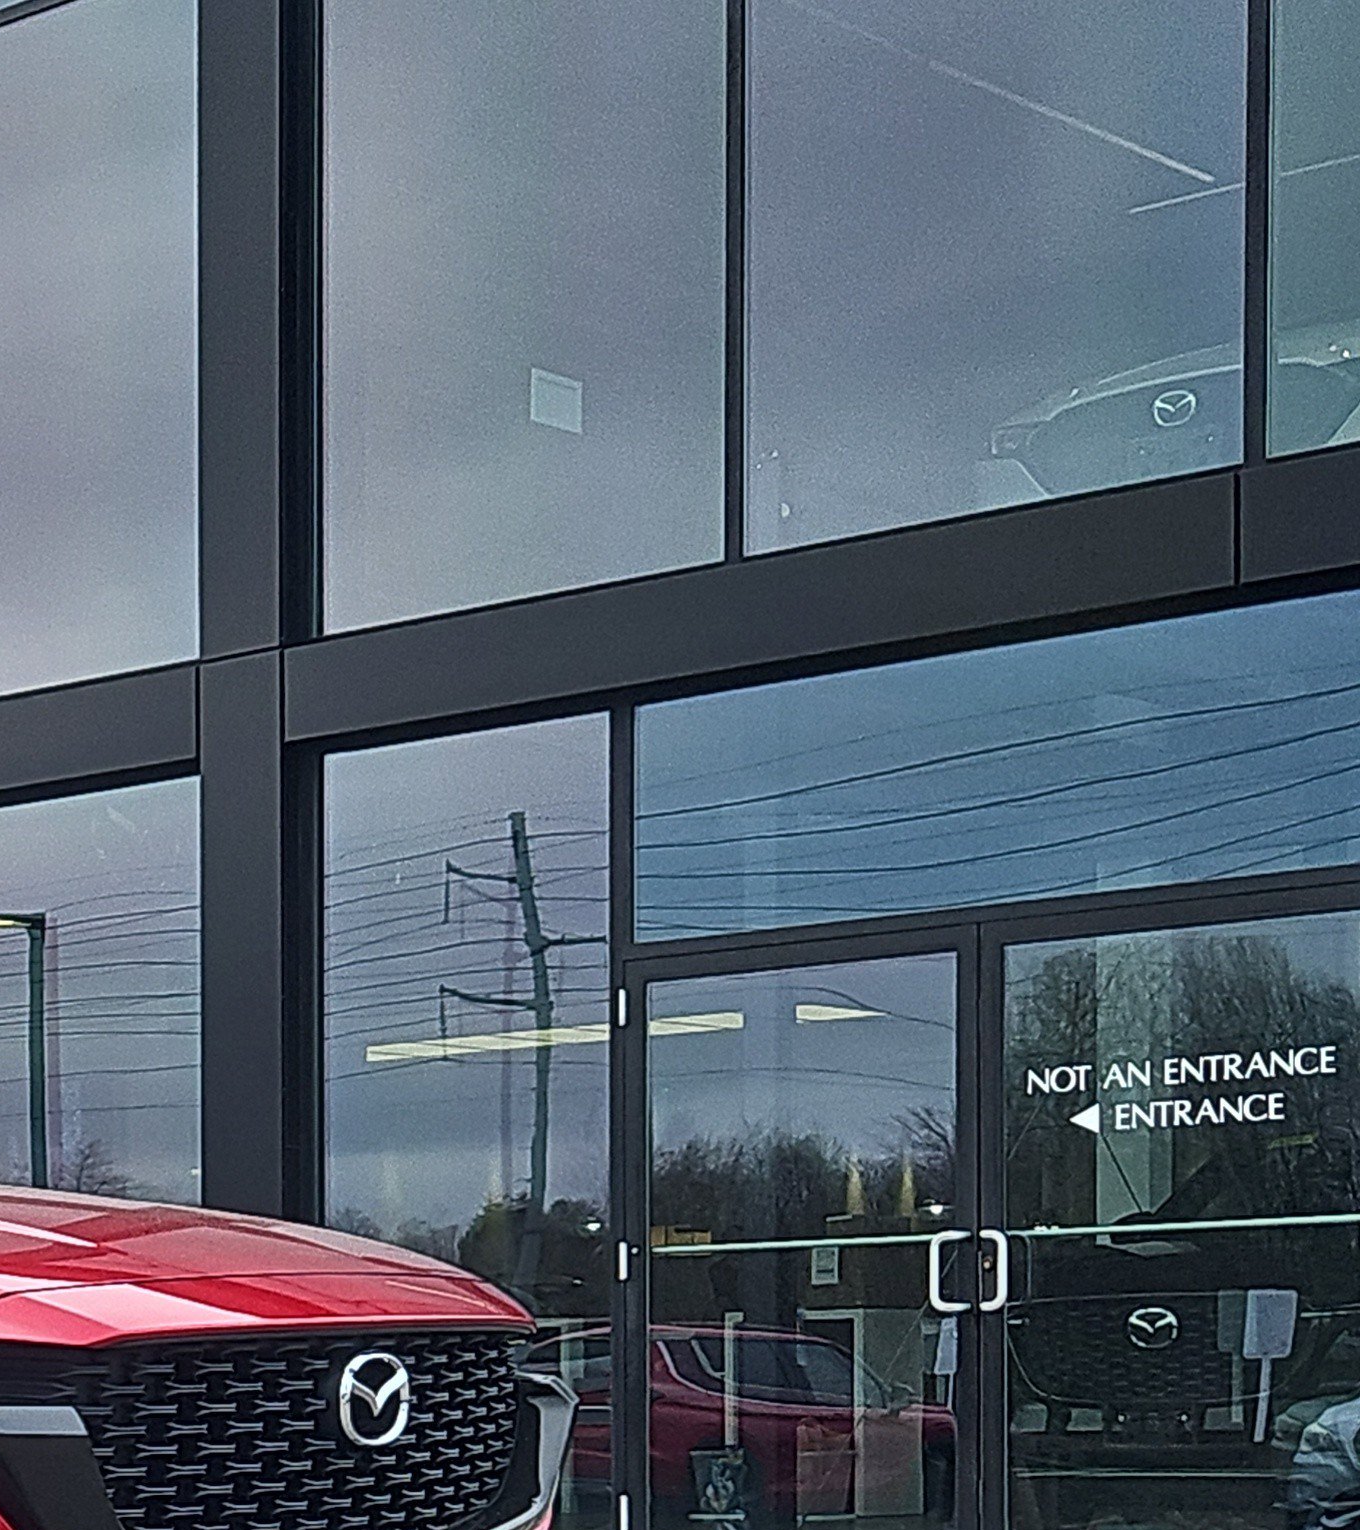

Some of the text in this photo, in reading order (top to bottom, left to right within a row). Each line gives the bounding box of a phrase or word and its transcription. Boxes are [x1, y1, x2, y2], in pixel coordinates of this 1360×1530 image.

[1026, 1046, 1337, 1095] NOT AN ENTRANCE
[1114, 1093, 1285, 1130] ENTRANCE
